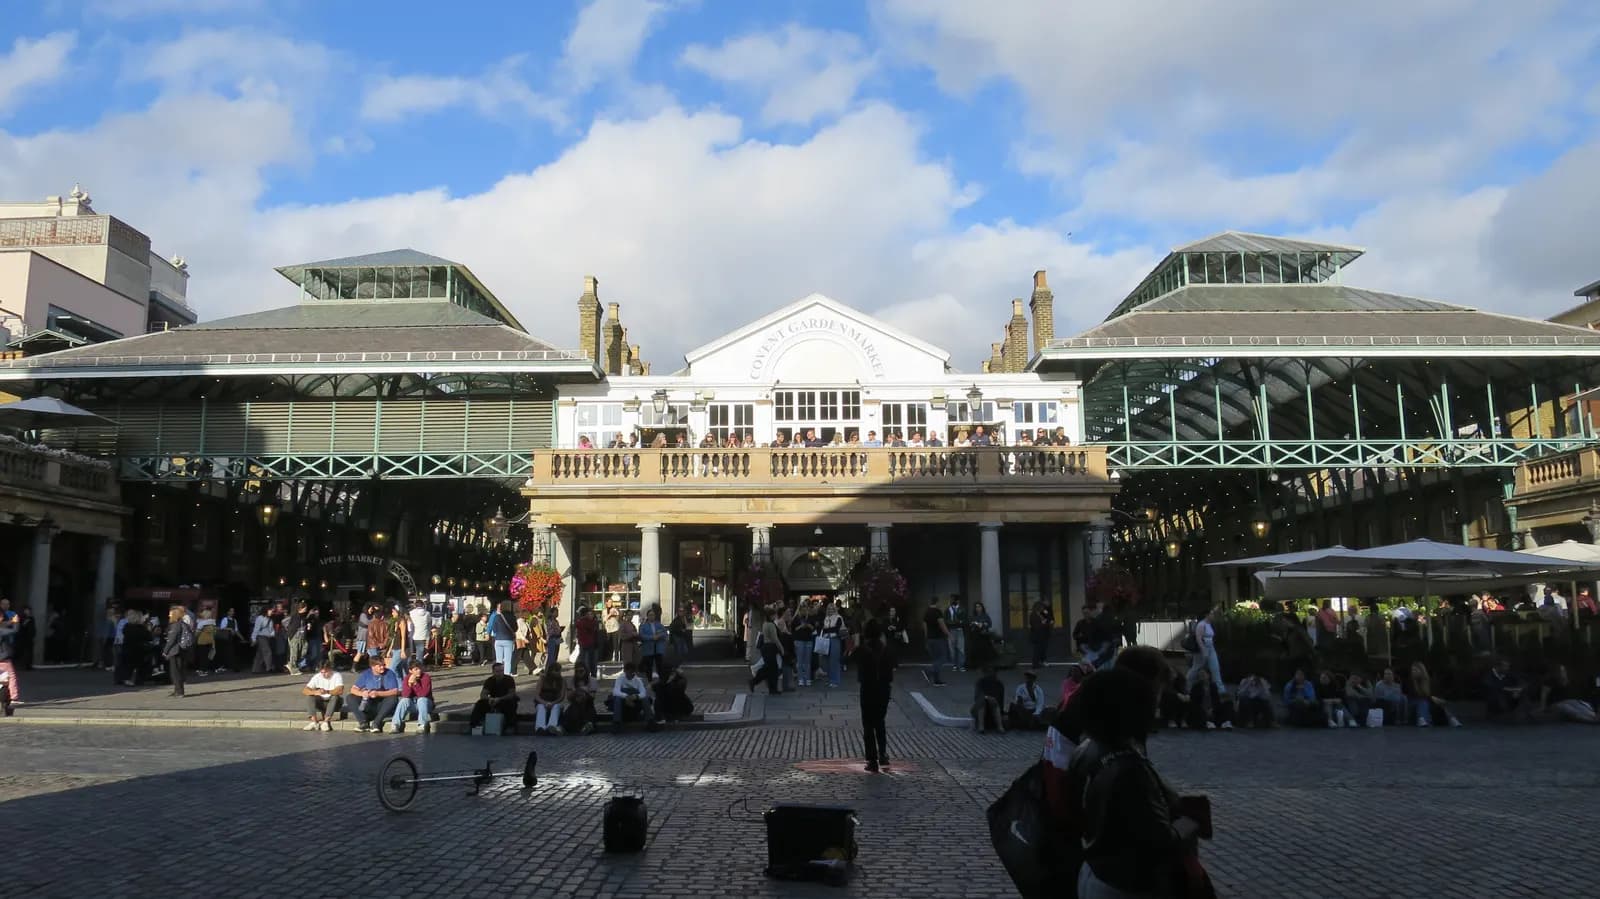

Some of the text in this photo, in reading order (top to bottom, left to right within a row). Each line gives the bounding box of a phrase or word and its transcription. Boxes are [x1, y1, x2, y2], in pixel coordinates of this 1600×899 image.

[750, 318, 884, 380] COVENT GARDEN MARKET
[319, 554, 384, 565] APPLE MARKET
